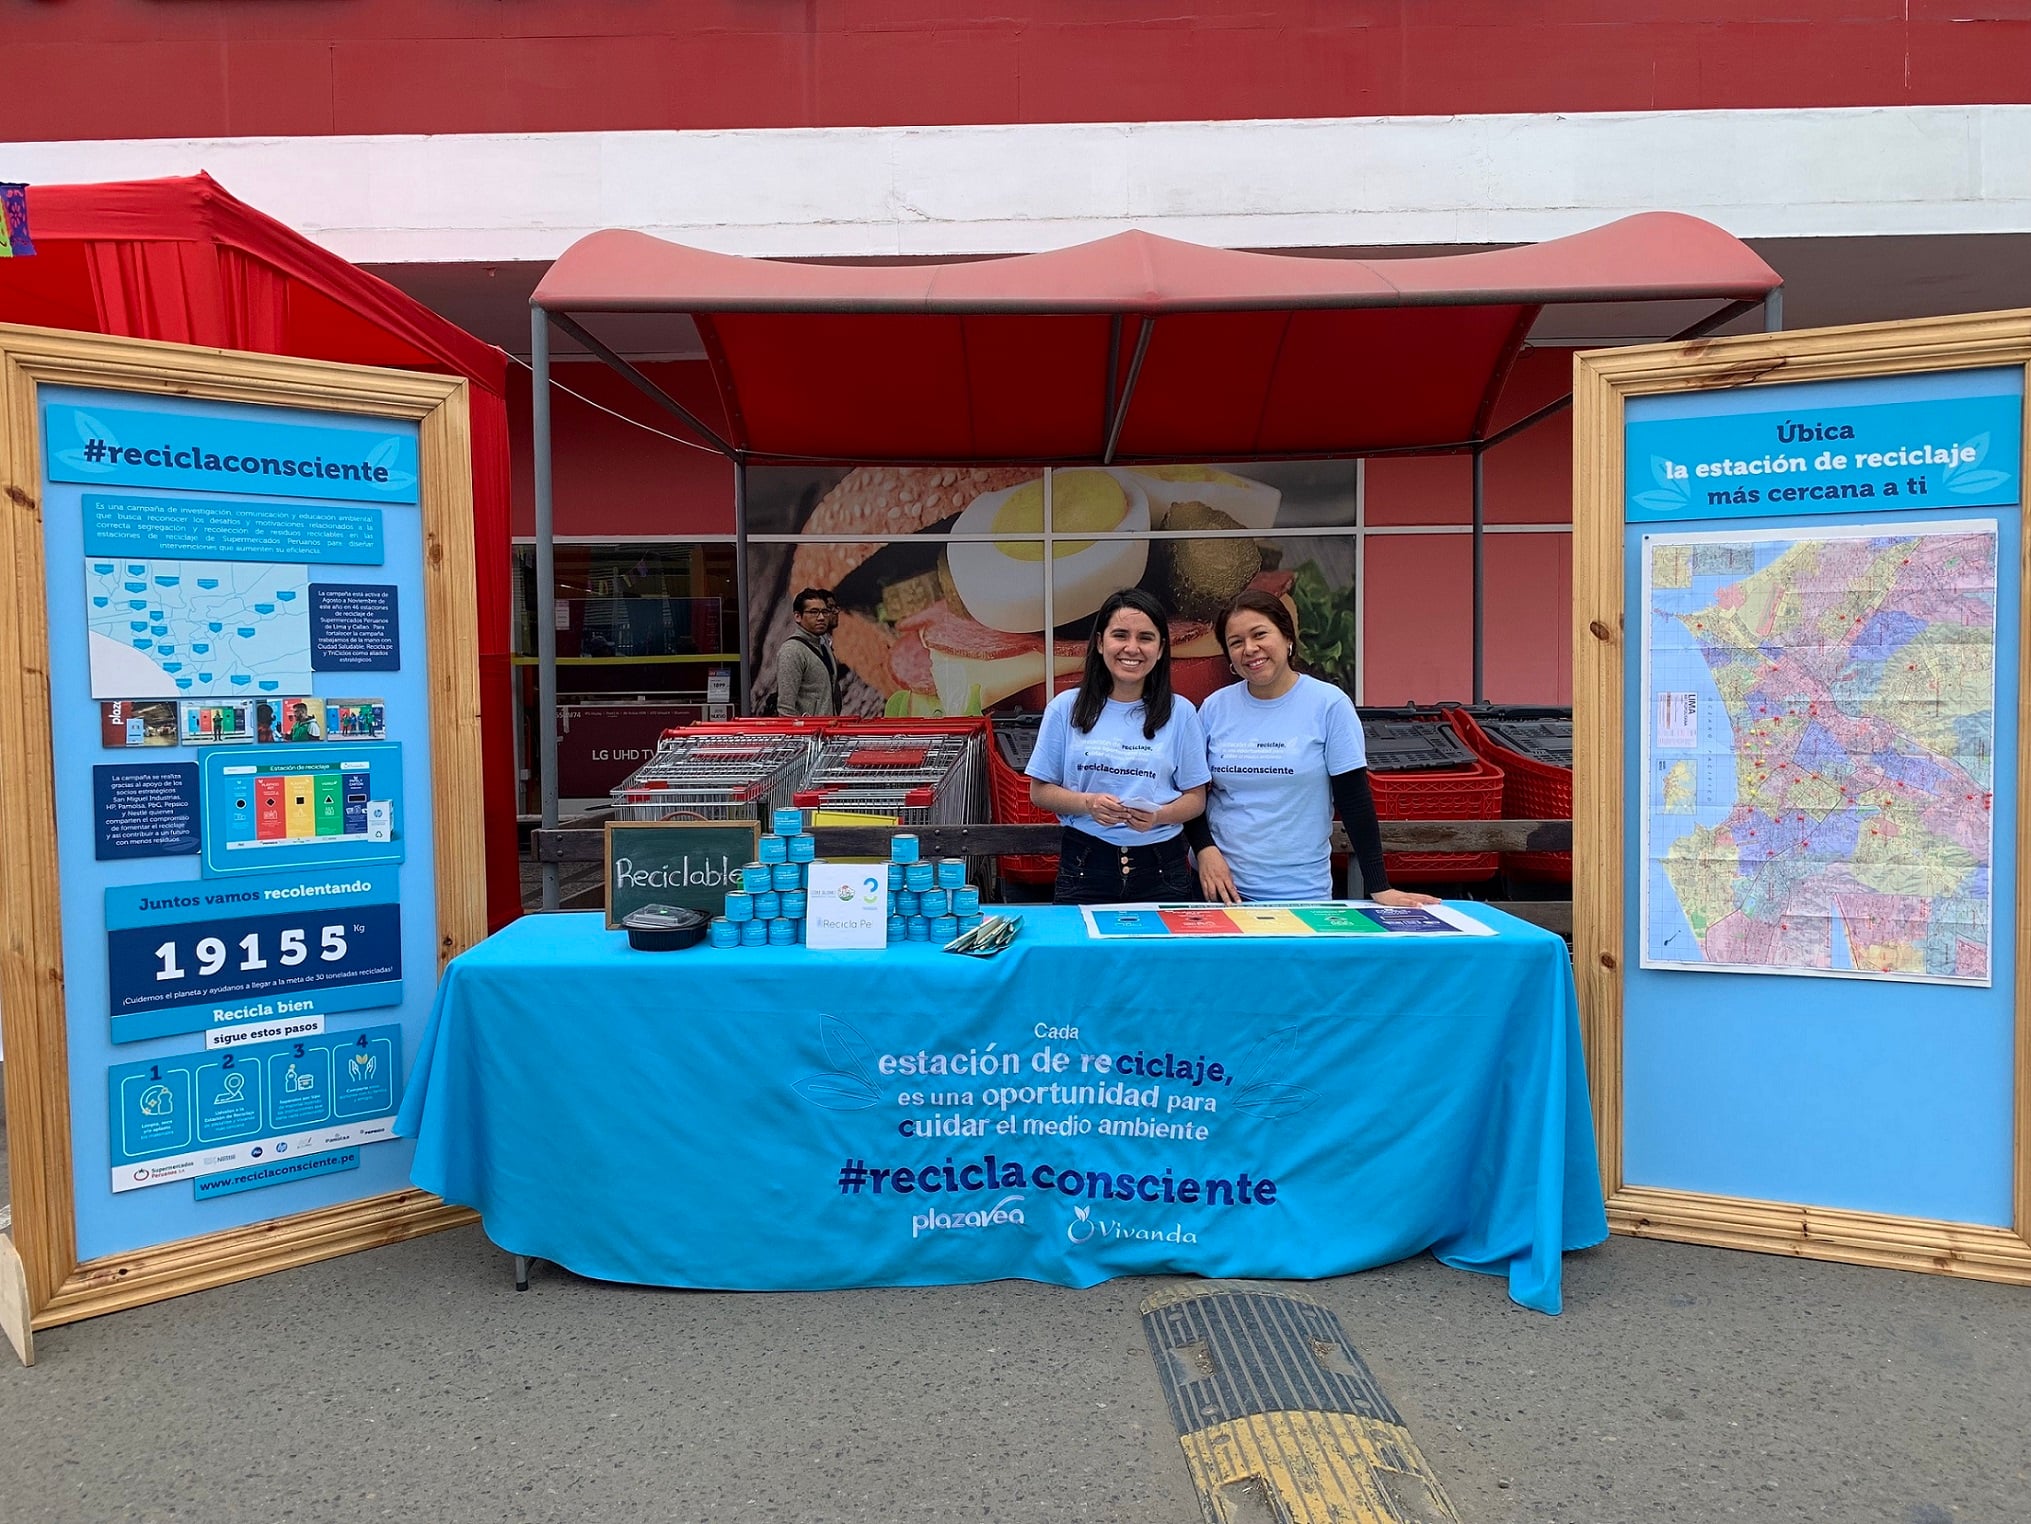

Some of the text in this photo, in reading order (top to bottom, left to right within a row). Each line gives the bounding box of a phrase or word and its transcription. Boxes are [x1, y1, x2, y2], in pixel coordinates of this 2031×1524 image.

[1776, 419, 1855, 444] Úbica
[84, 438, 389, 483] #reciclaconsciente
[1665, 443, 1976, 480] la estación de reciclaje
[1708, 476, 1928, 506] más cercana a ti
[108, 701, 124, 724] plaz
[592, 750, 608, 760] LG
[613, 750, 640, 760] UHD
[615, 856, 742, 890] Reciclable
[139, 880, 372, 911] Juntos vamos recolentando
[154, 924, 366, 981] 19155 Kg
[174, 988, 202, 1000] planeta
[252, 980, 271, 990] llegar
[286, 976, 304, 984] meta
[326, 970, 358, 980] toneladas
[359, 966, 393, 976] recicladas!
[213, 998, 314, 1023] Recicla bien
[214, 1022, 318, 1045] sigue estos pasos
[356, 1034, 368, 1048] 4
[1034, 1022, 1080, 1041] Cada
[222, 1054, 235, 1070] 2
[293, 1043, 305, 1058] 3
[878, 1042, 1234, 1089] estación de reciclaje,
[150, 1064, 162, 1081] 1
[897, 1081, 1217, 1114] es una oportunidad para
[898, 1112, 1209, 1142] cuidar el medio ambiente
[200, 1154, 355, 1191] www.reciclaconsciente.pe
[838, 1155, 1278, 1206] #reciclaconsciente
[1098, 1220, 1198, 1244] Vivanda
